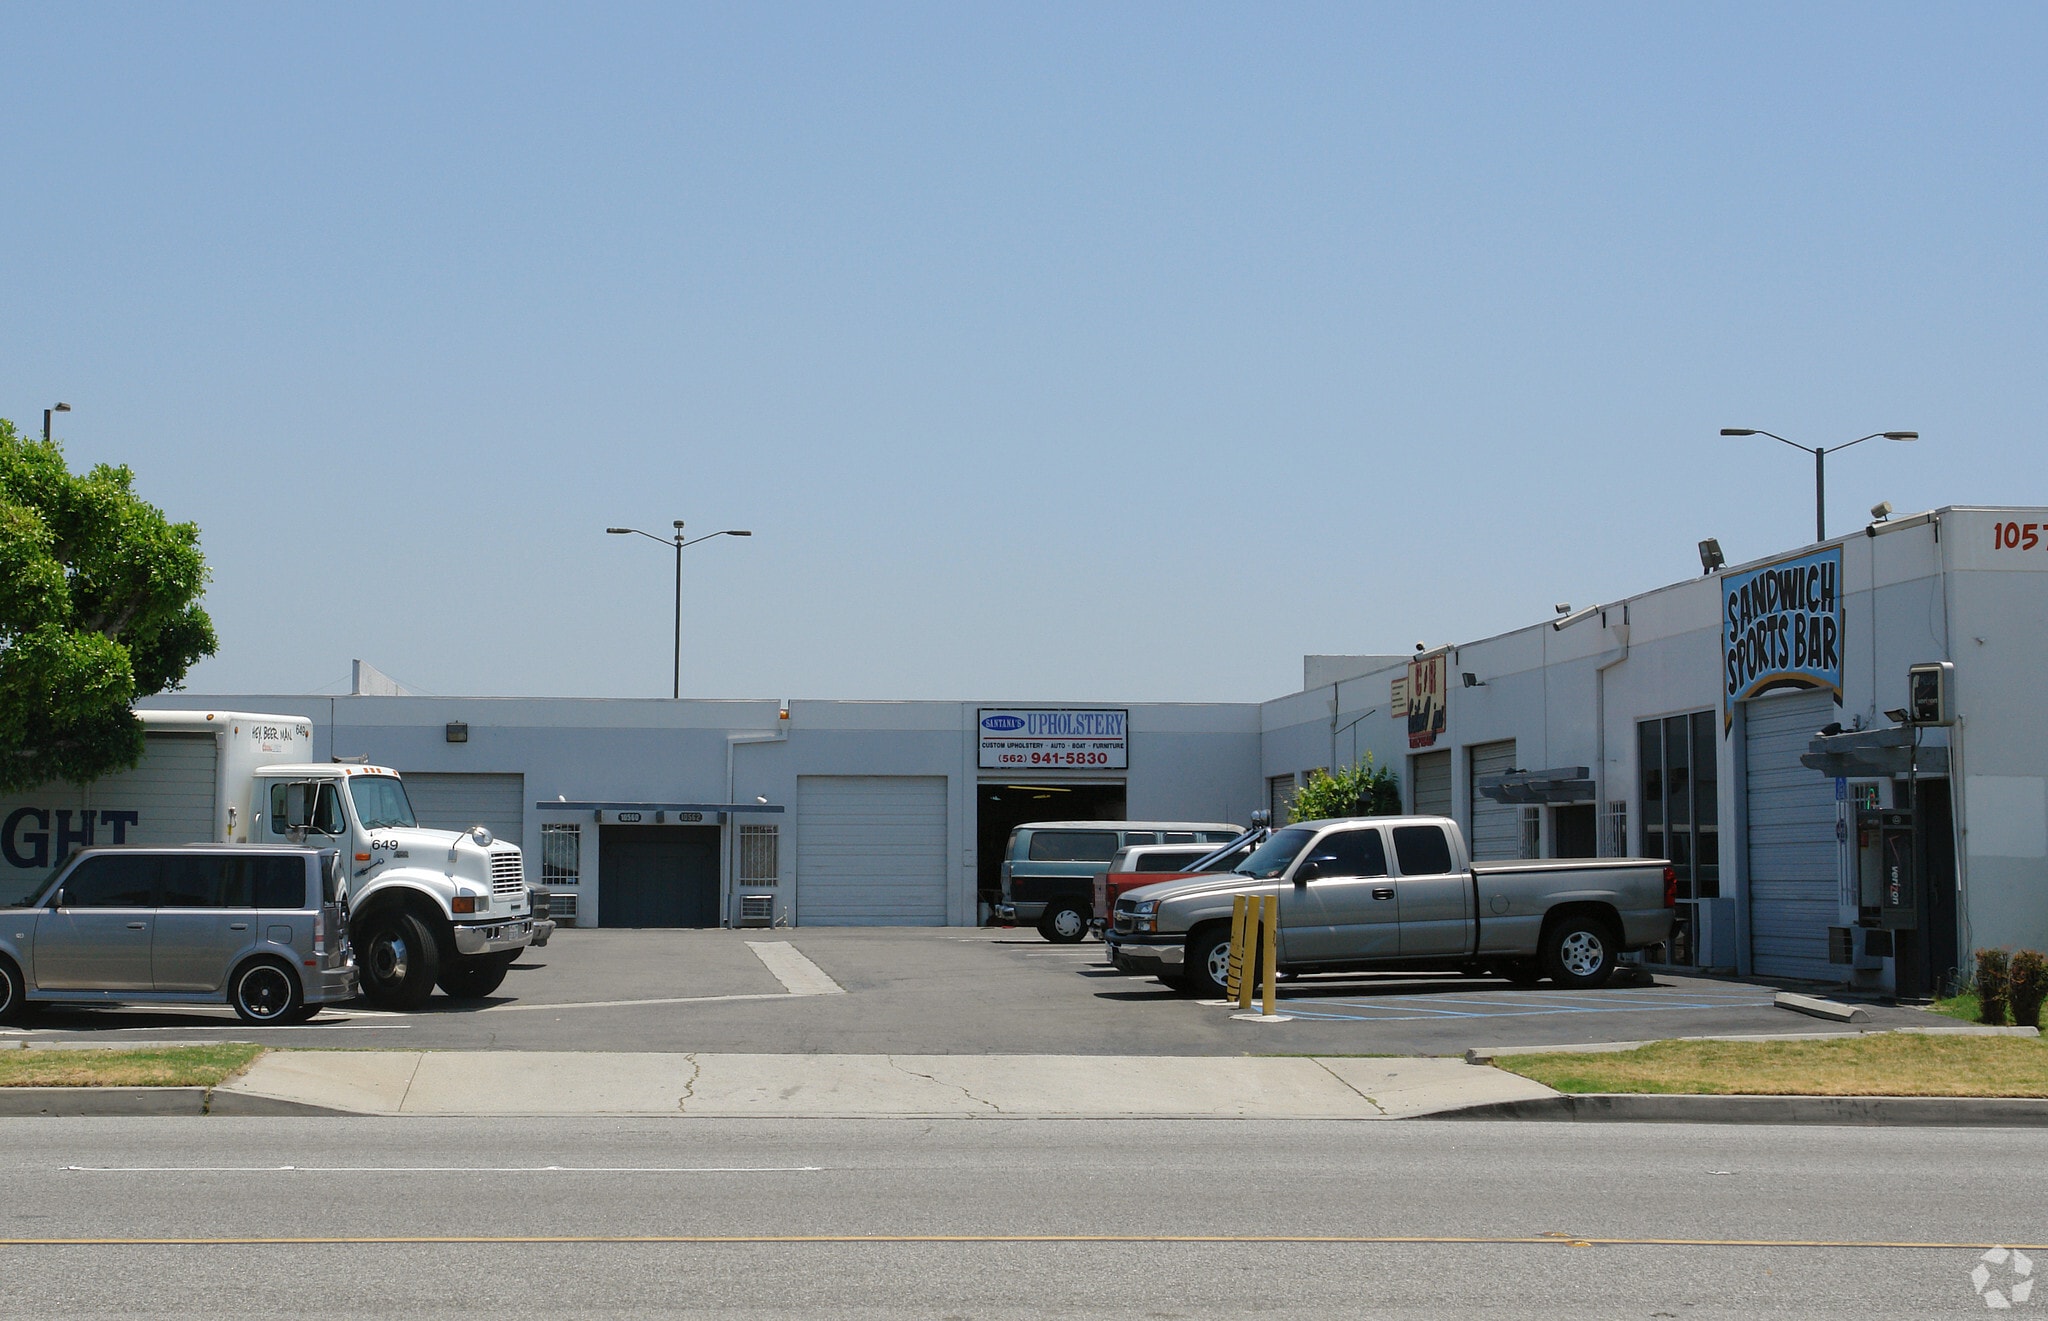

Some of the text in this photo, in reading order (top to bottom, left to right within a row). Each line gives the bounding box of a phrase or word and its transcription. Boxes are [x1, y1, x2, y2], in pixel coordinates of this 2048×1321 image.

[1728, 562, 1836, 643] SANDWICH
[1728, 612, 1838, 696] SPORTS BAR
[264, 726, 279, 740] BEER
[280, 727, 293, 741] MAN
[985, 713, 1124, 735] SANTANA'S UPHOLSTERY
[998, 752, 1108, 764] (562) 941-5830
[372, 839, 399, 850] 649
[1890, 865, 1901, 905] verizon
